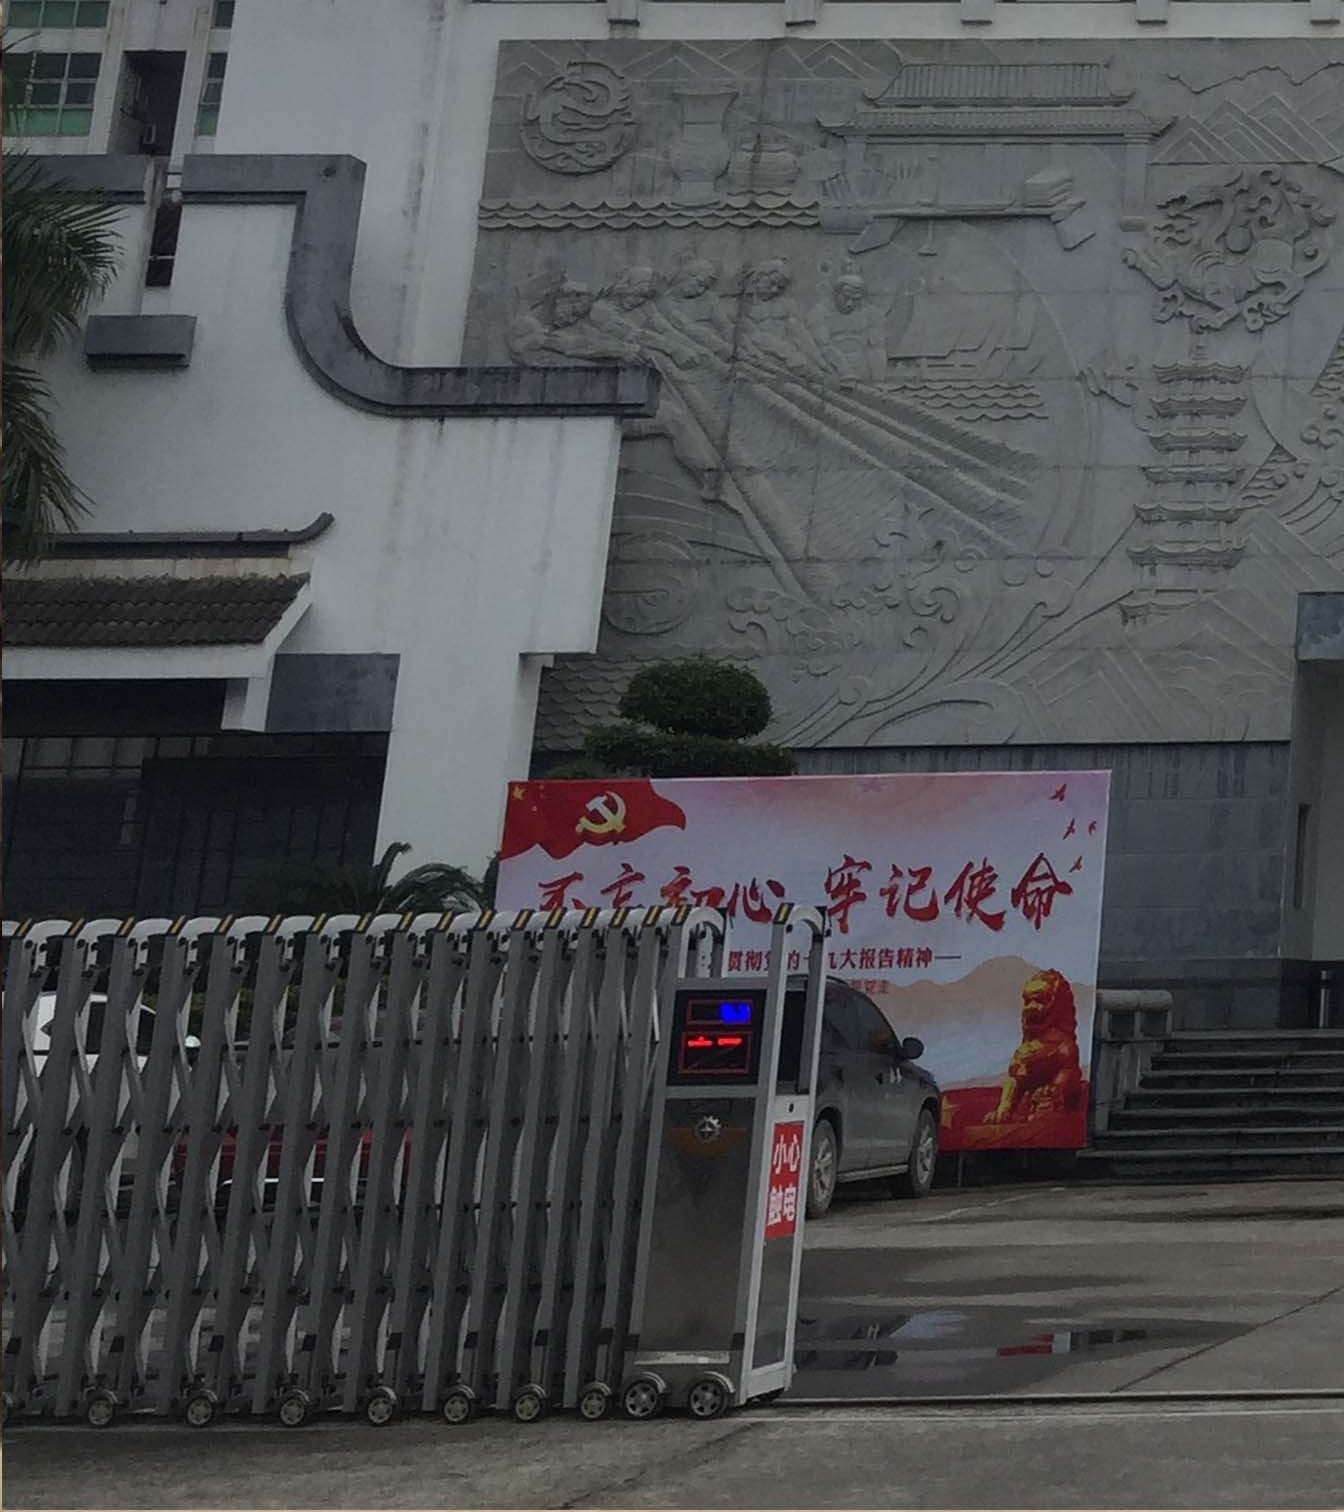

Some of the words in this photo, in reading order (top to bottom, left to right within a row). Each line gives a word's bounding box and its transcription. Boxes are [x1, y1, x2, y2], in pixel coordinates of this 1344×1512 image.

[822, 852, 1074, 934] 牢记使命
[772, 1132, 801, 1175] 小心
